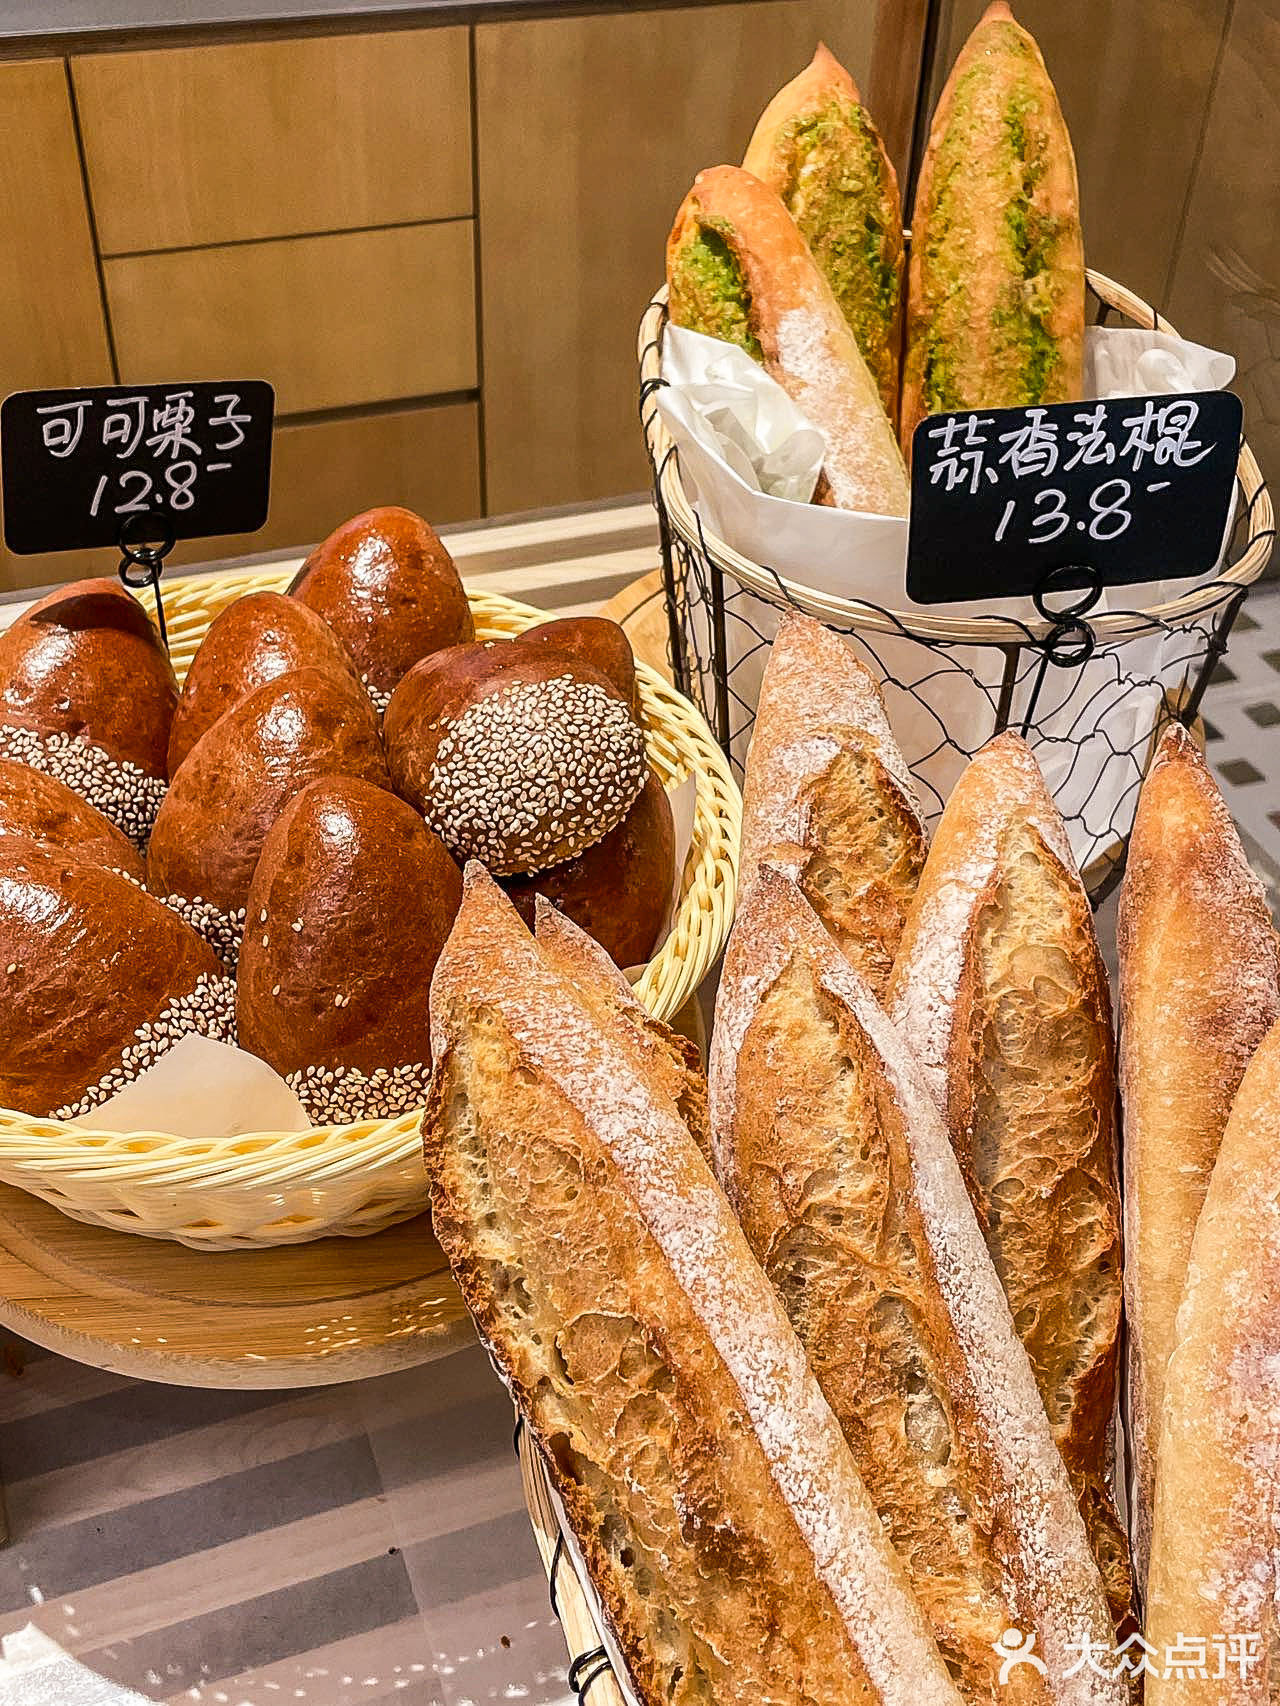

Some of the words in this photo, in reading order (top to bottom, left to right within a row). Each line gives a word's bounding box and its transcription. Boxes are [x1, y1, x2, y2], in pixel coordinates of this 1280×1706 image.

[37, 391, 252, 458] 可可栗子
[928, 400, 1217, 493] 蒜香法棍
